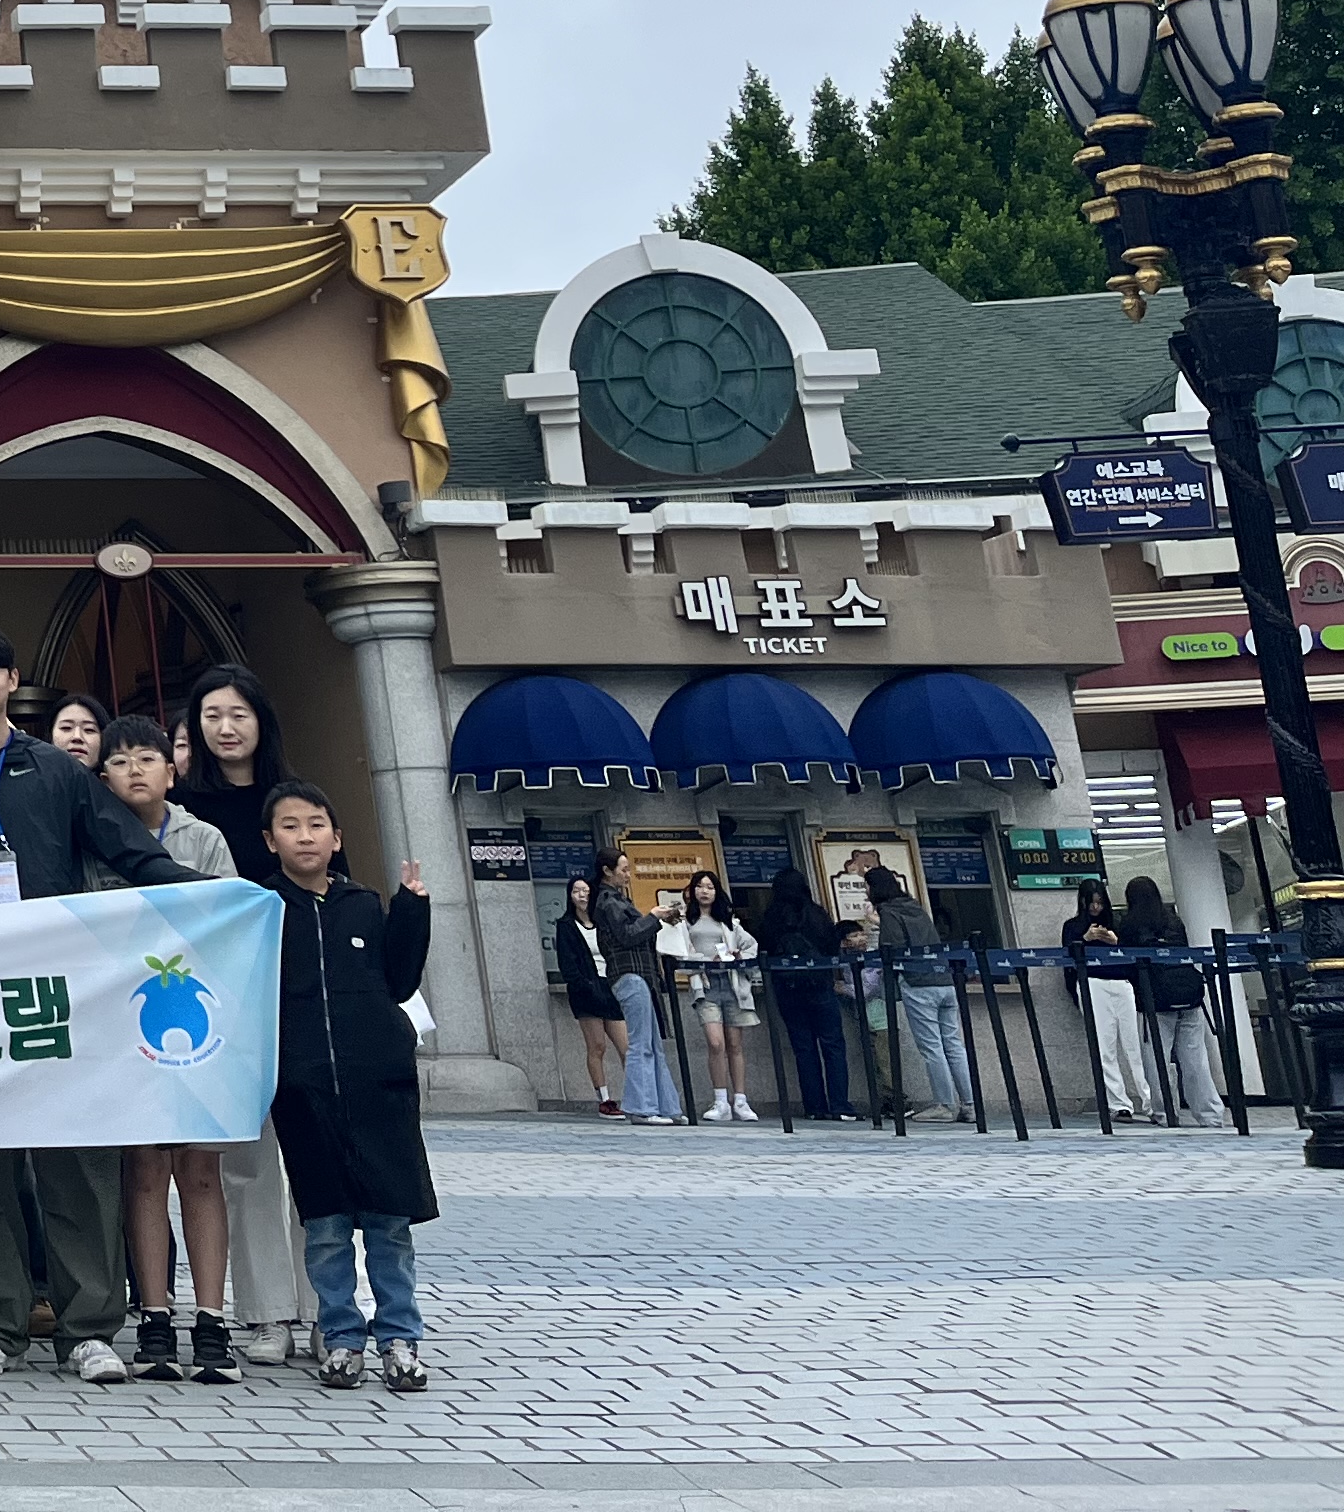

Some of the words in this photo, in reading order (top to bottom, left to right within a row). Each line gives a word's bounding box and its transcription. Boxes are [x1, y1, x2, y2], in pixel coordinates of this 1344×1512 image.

[1136, 488, 1174, 503] 서비스
[1175, 483, 1205, 501] 센터
[681, 576, 887, 633] 매표소
[743, 637, 828, 654] TICKET
[1172, 640, 1208, 654] Nice
[1211, 640, 1228, 651] to
[1018, 840, 1040, 848] OPEN
[1062, 839, 1089, 847] CLOSE
